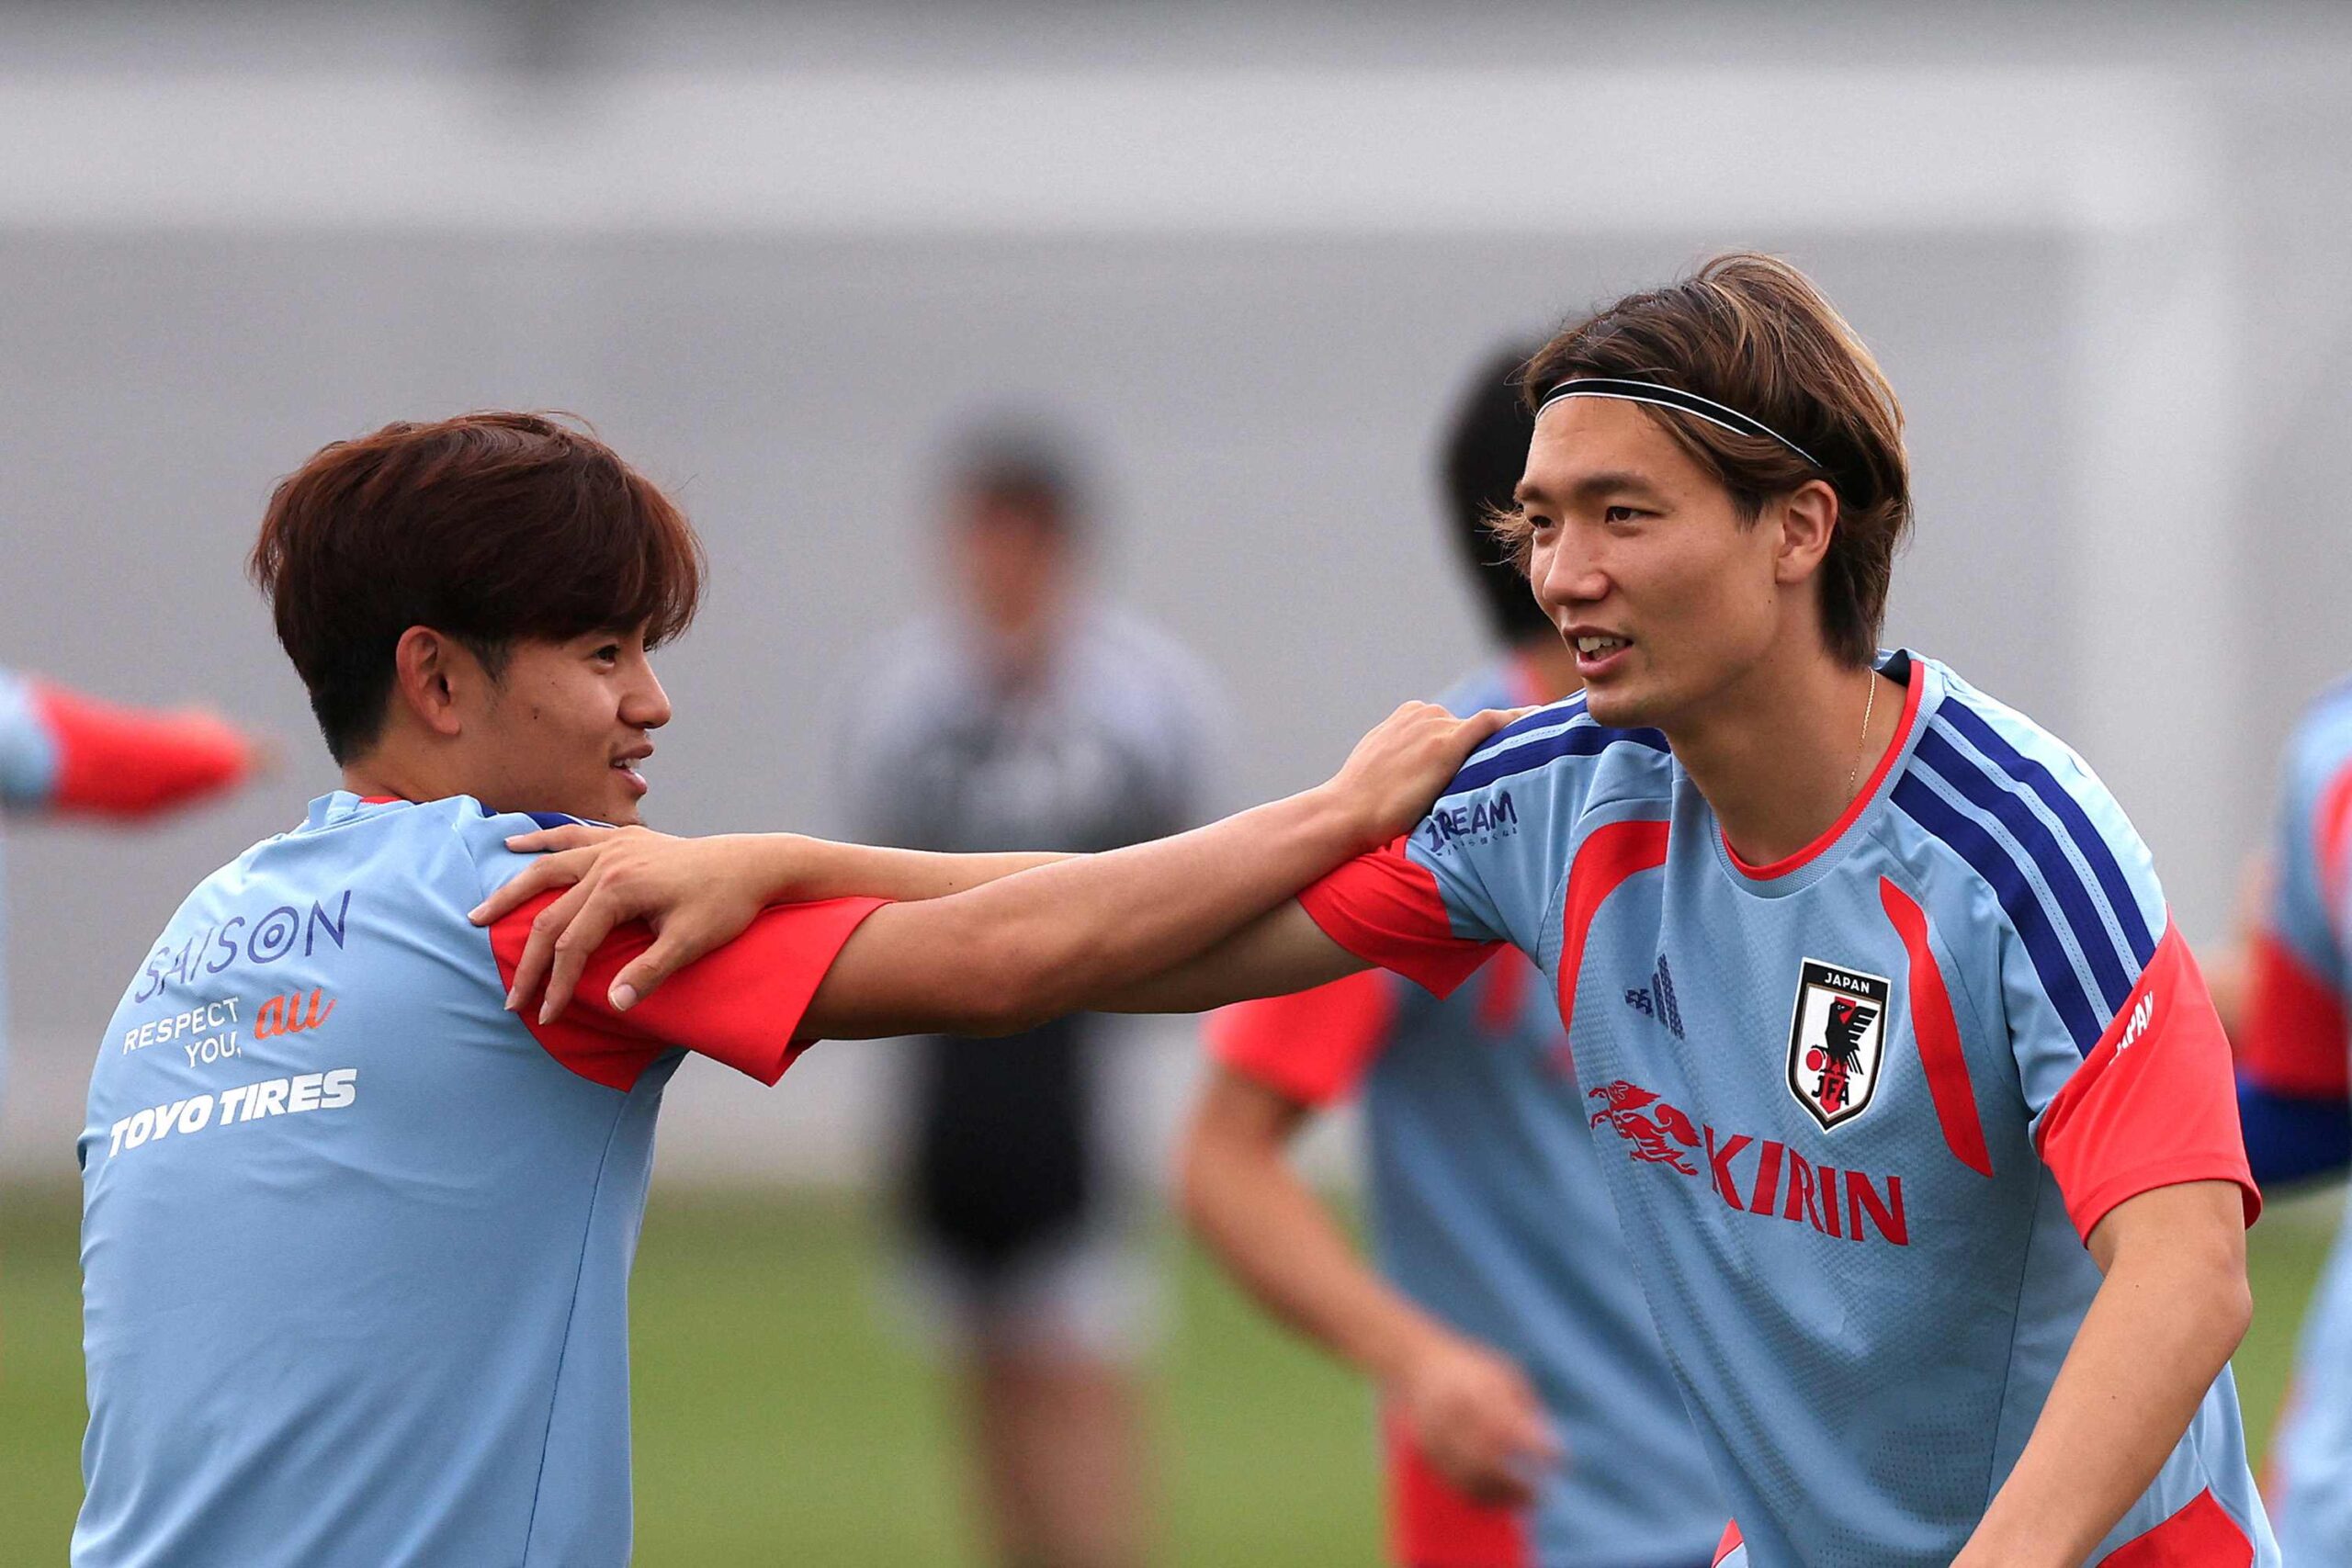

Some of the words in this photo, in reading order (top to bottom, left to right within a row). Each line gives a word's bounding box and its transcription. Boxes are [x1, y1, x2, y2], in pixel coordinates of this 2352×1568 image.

[134, 889, 351, 1004] SAISON
[1824, 972, 1871, 995] JAPAN
[122, 997, 239, 1055] RESPECT
[254, 987, 336, 1041] au
[185, 1031, 242, 1068] YOU,
[108, 1094, 215, 1158] TOYO
[219, 1068, 358, 1126] TIRES
[1811, 1074, 1850, 1107] JFA
[1702, 1123, 1909, 1247] KIRIN
